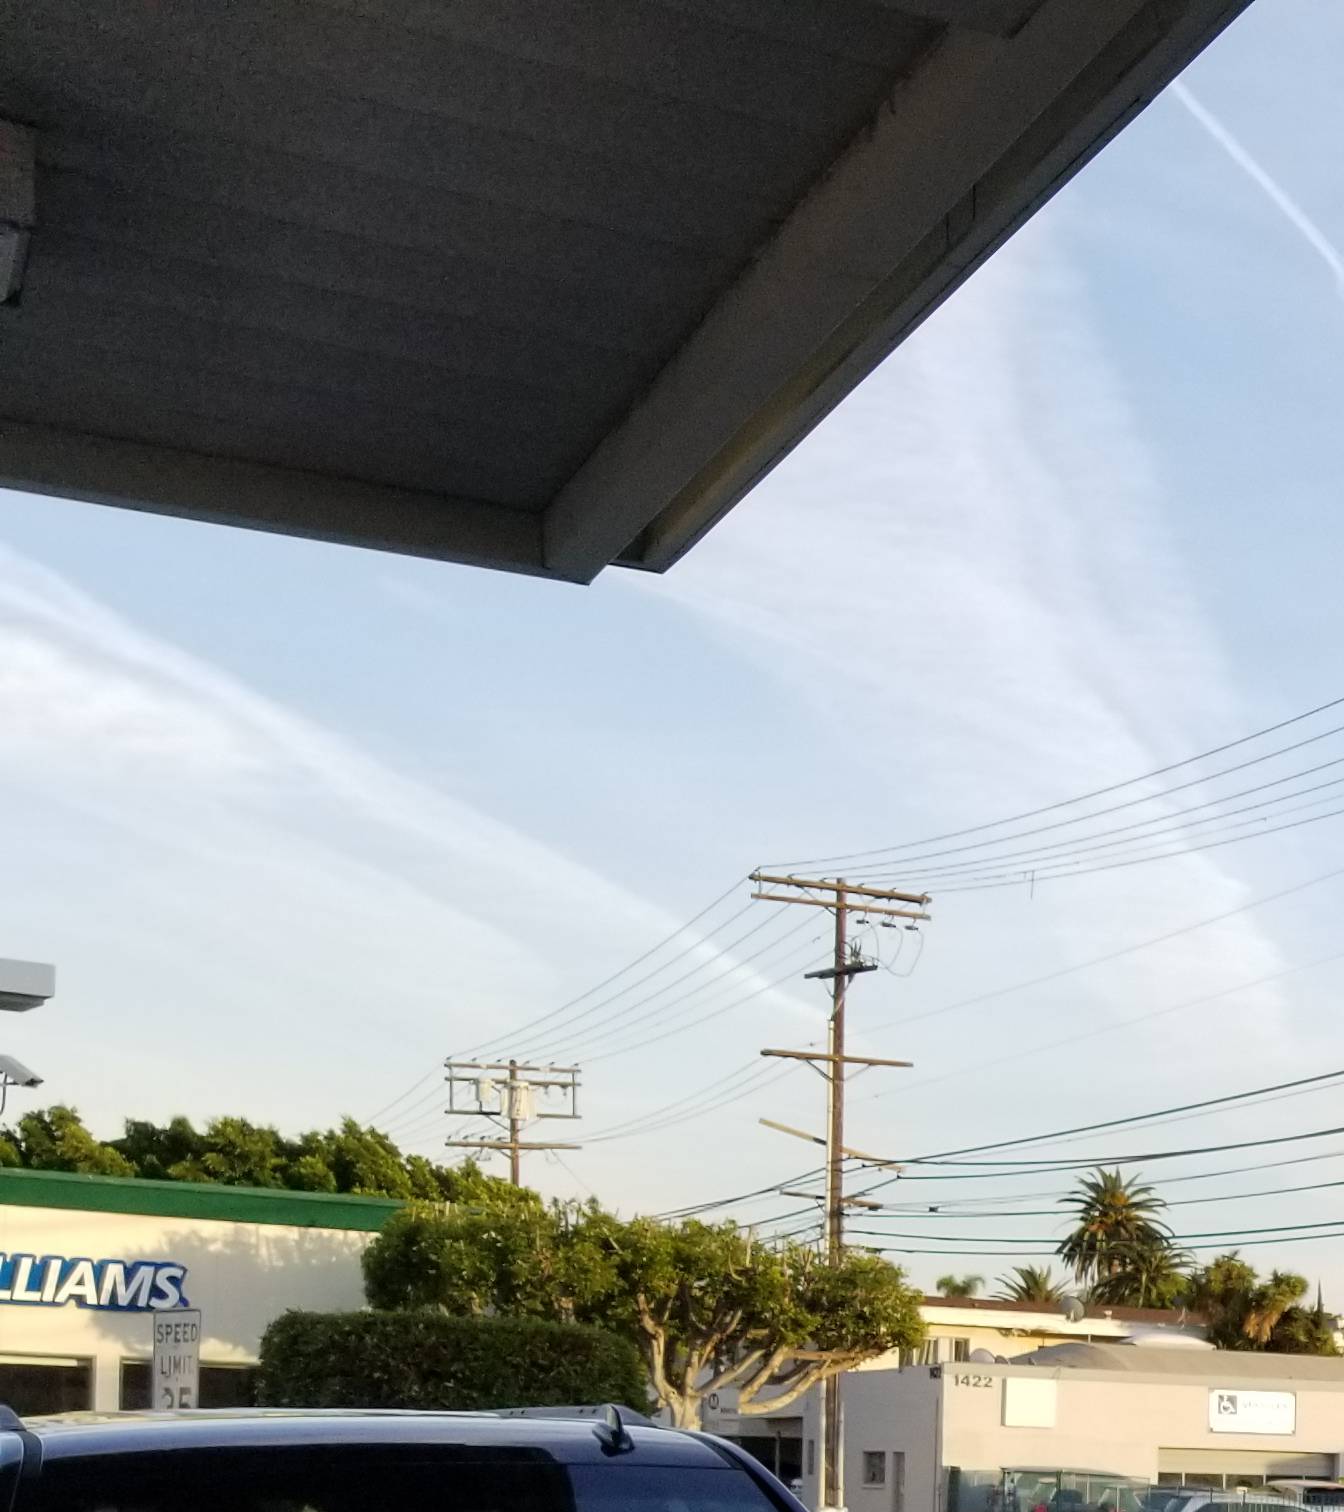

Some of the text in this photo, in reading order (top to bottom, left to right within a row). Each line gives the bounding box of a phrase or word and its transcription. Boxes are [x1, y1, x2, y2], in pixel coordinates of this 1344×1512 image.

[157, 1323, 198, 1343] SPEED
[160, 1355, 194, 1376] LIMIT
[954, 1374, 993, 1388] 1422
